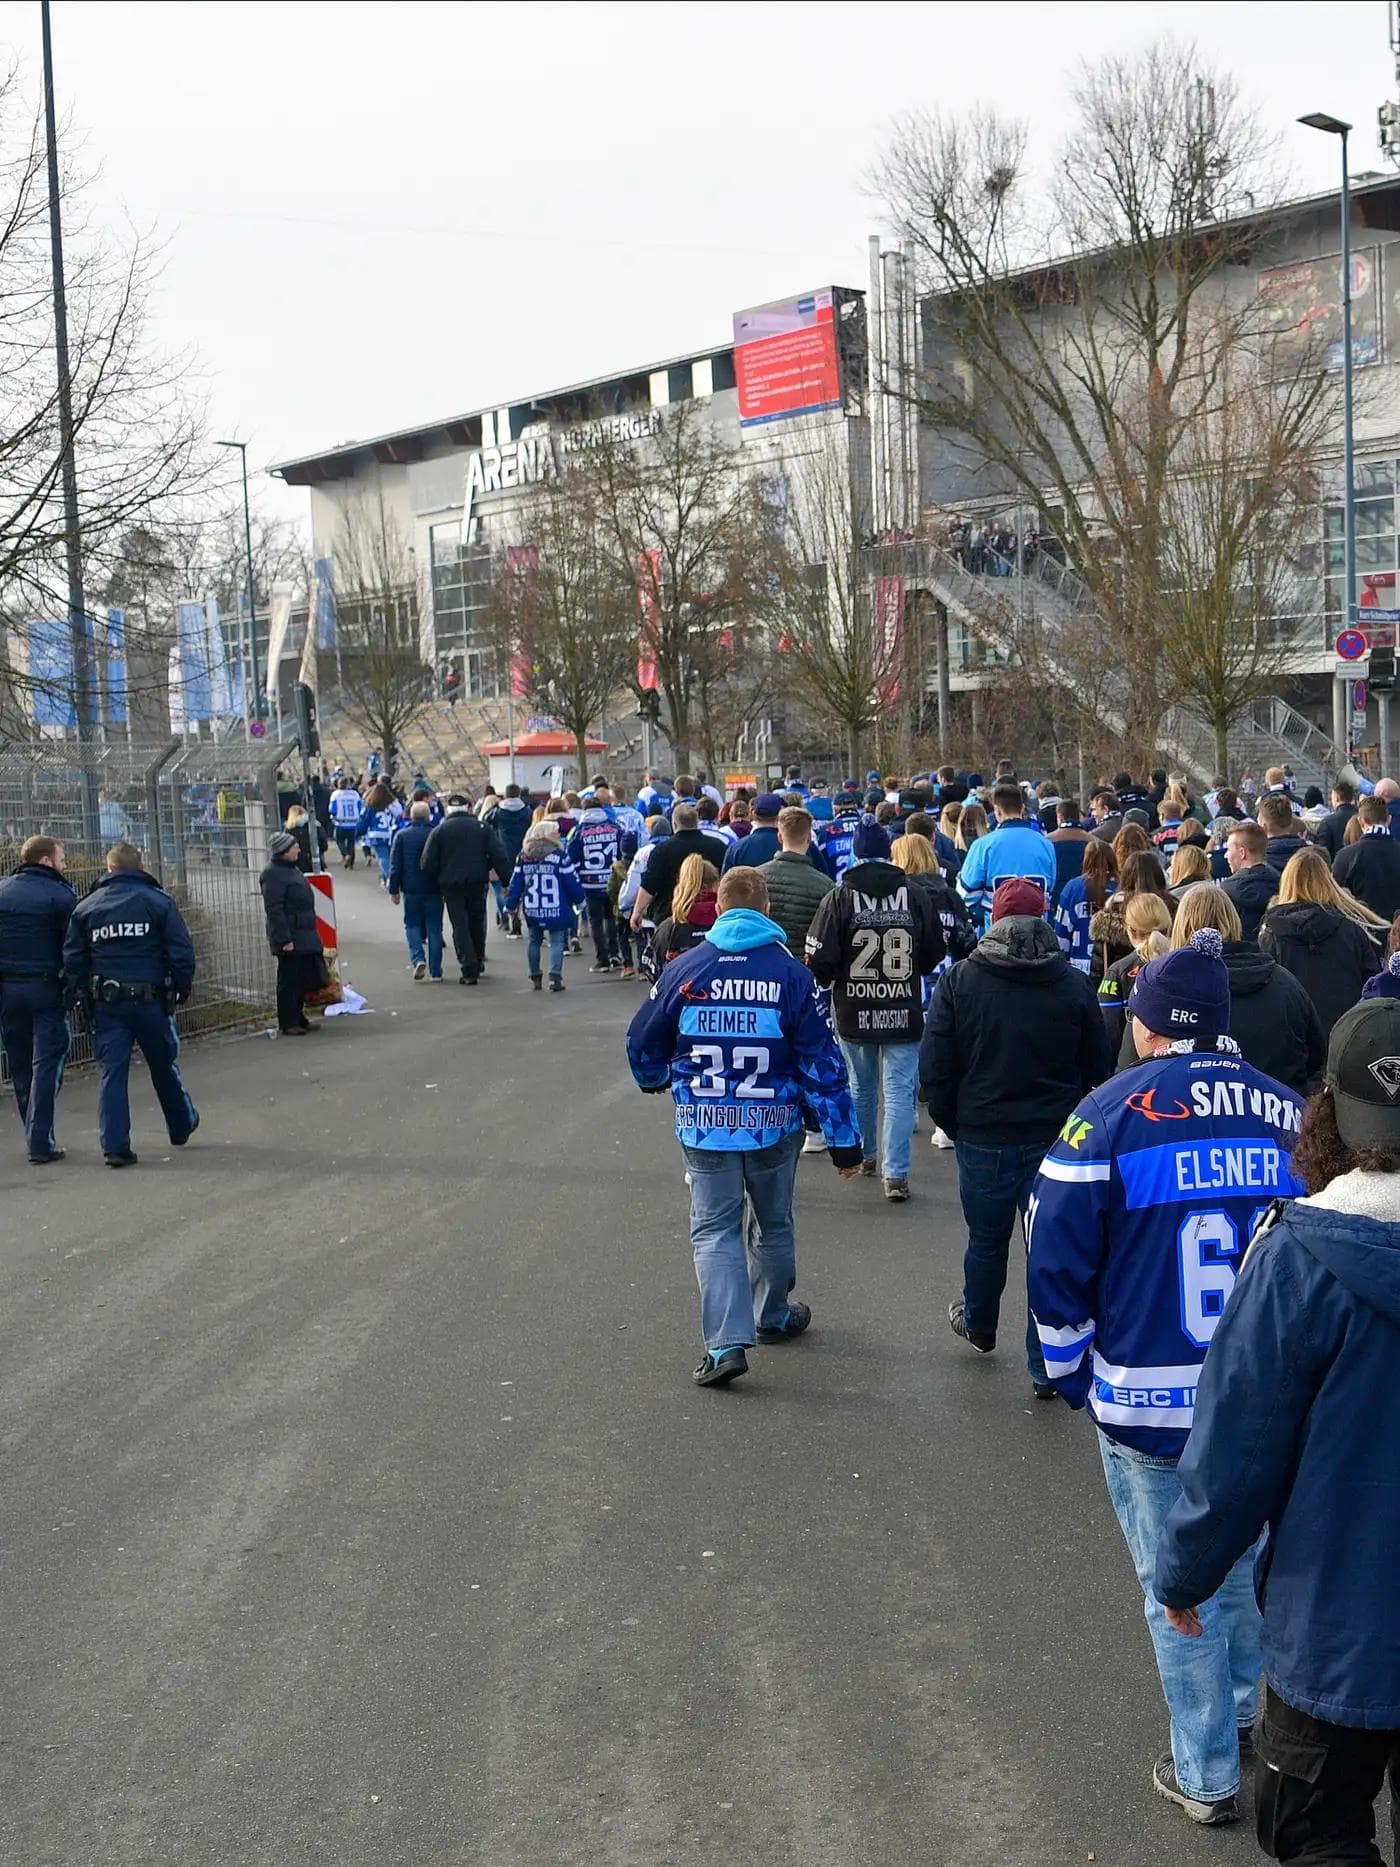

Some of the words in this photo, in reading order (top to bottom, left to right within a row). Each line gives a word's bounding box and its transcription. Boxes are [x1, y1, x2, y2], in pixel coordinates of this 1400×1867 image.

[582, 842, 619, 870] 51
[524, 873, 560, 909] 39
[849, 928, 913, 981] 28
[710, 978, 781, 1003] SATURN
[846, 982, 913, 999] DONOVAN
[697, 1010, 757, 1034] REIMER
[1170, 1008, 1200, 1024] ERC
[689, 1044, 775, 1099] 32
[697, 1104, 797, 1129] INGOLSTADT
[1190, 1080, 1302, 1135] SATURN
[1175, 1147, 1281, 1192] ELSNER
[1112, 1388, 1172, 1407] ERC
